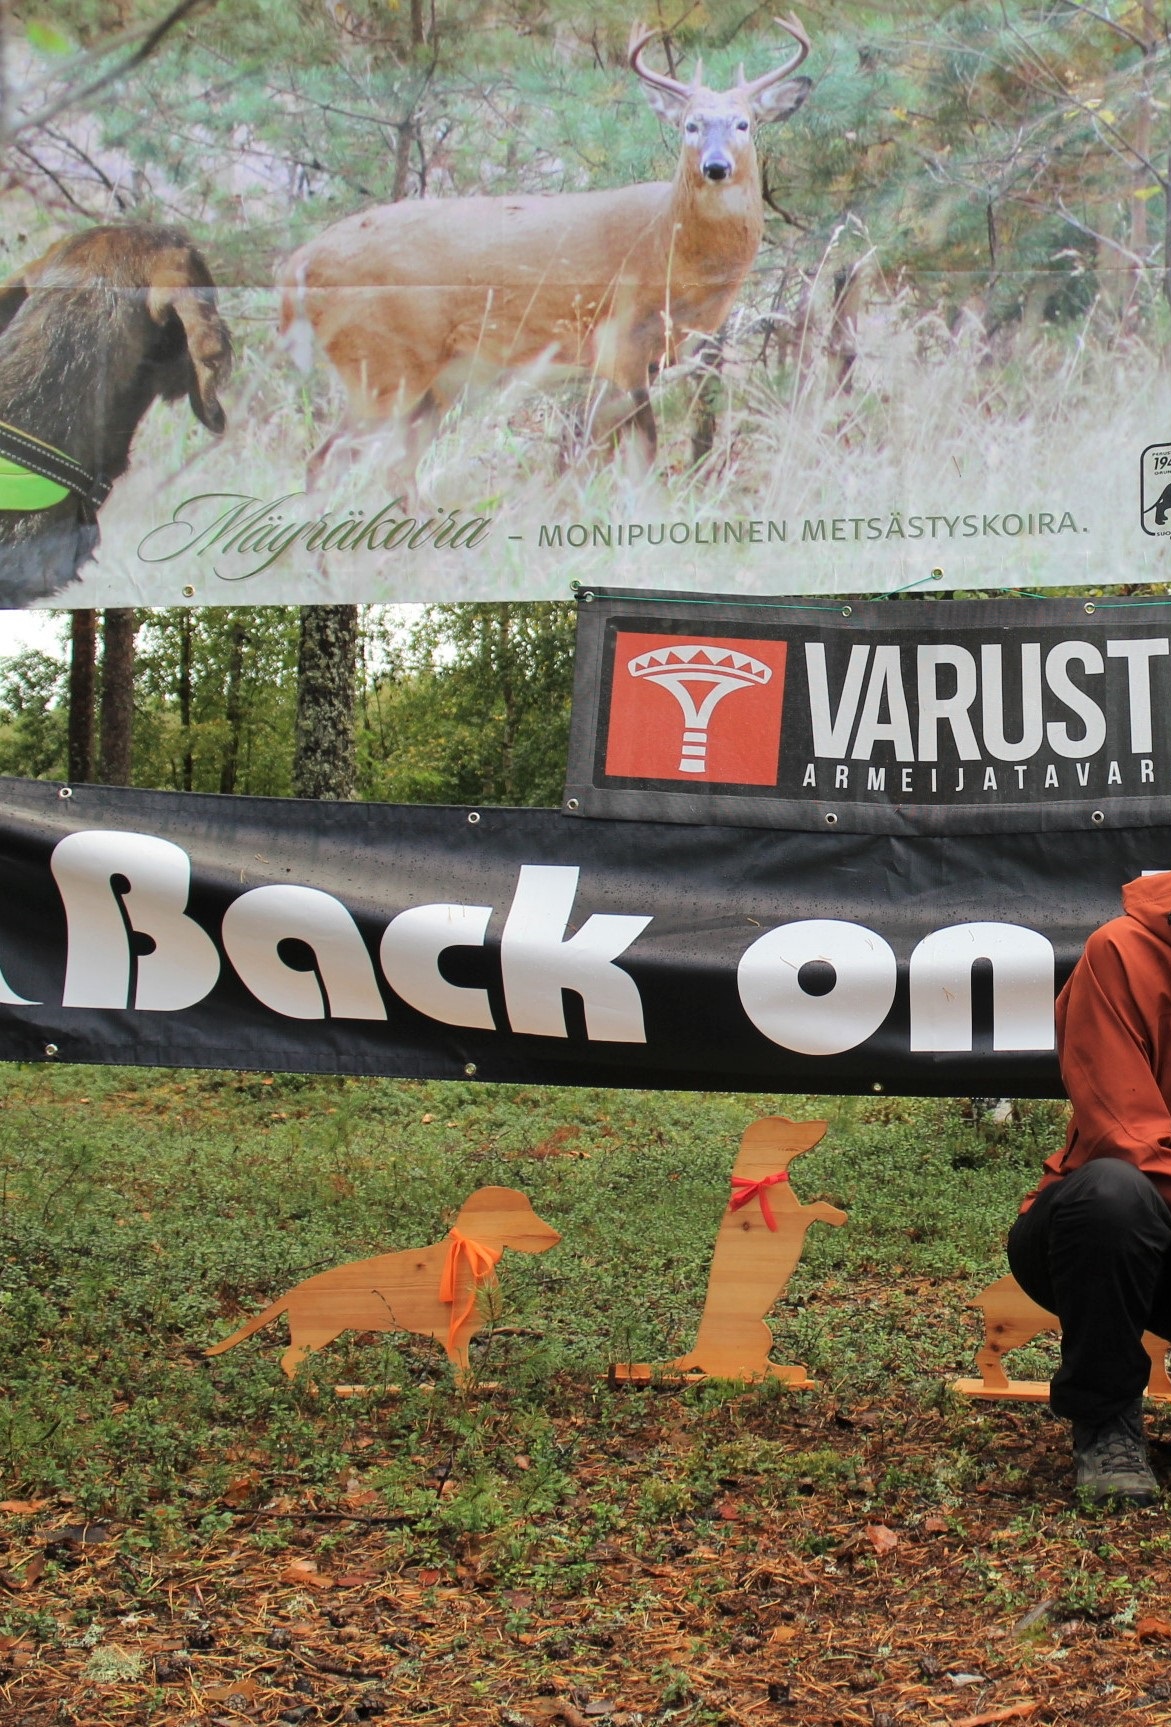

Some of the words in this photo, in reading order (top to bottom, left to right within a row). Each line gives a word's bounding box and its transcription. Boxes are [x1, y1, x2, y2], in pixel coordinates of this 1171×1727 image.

[137, 491, 491, 582] Mäyräkoira
[537, 519, 787, 548] MONIPUOLINEN
[801, 510, 1090, 542] METSÄSTYSKOIRA.
[50, 830, 654, 1044] Back
[737, 919, 1056, 1056] on
